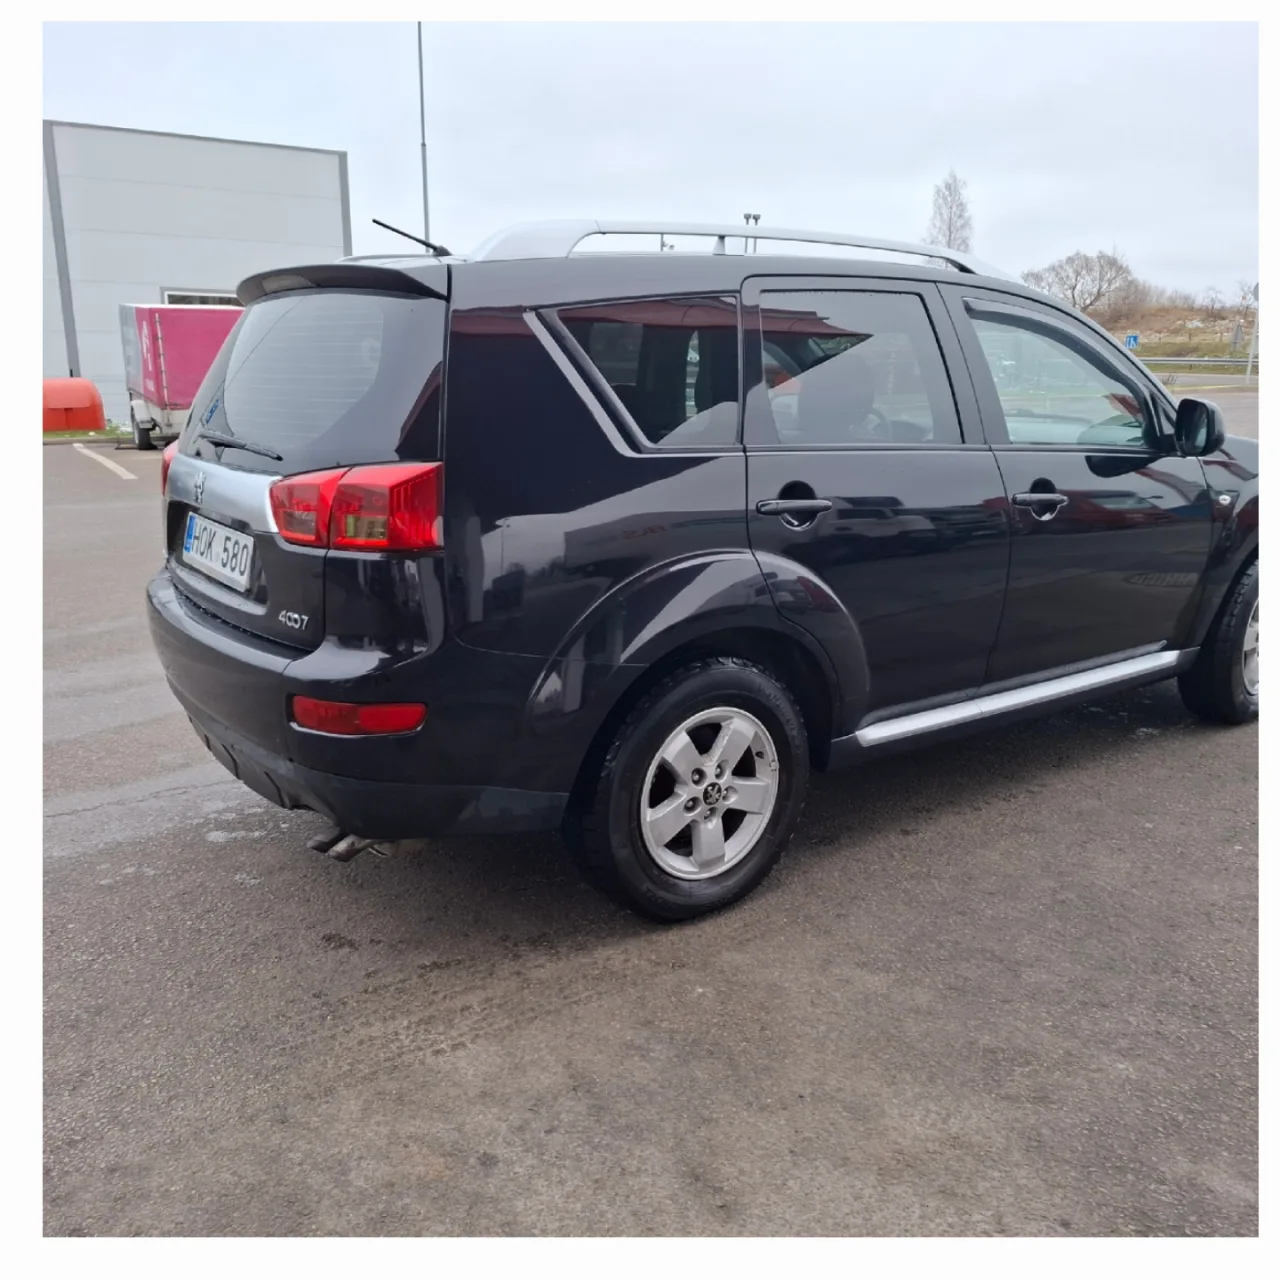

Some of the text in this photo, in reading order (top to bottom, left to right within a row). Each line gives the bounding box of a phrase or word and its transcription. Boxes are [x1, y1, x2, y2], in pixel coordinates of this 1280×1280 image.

[191, 520, 249, 577] HOK 580
[278, 610, 309, 631] 4007
